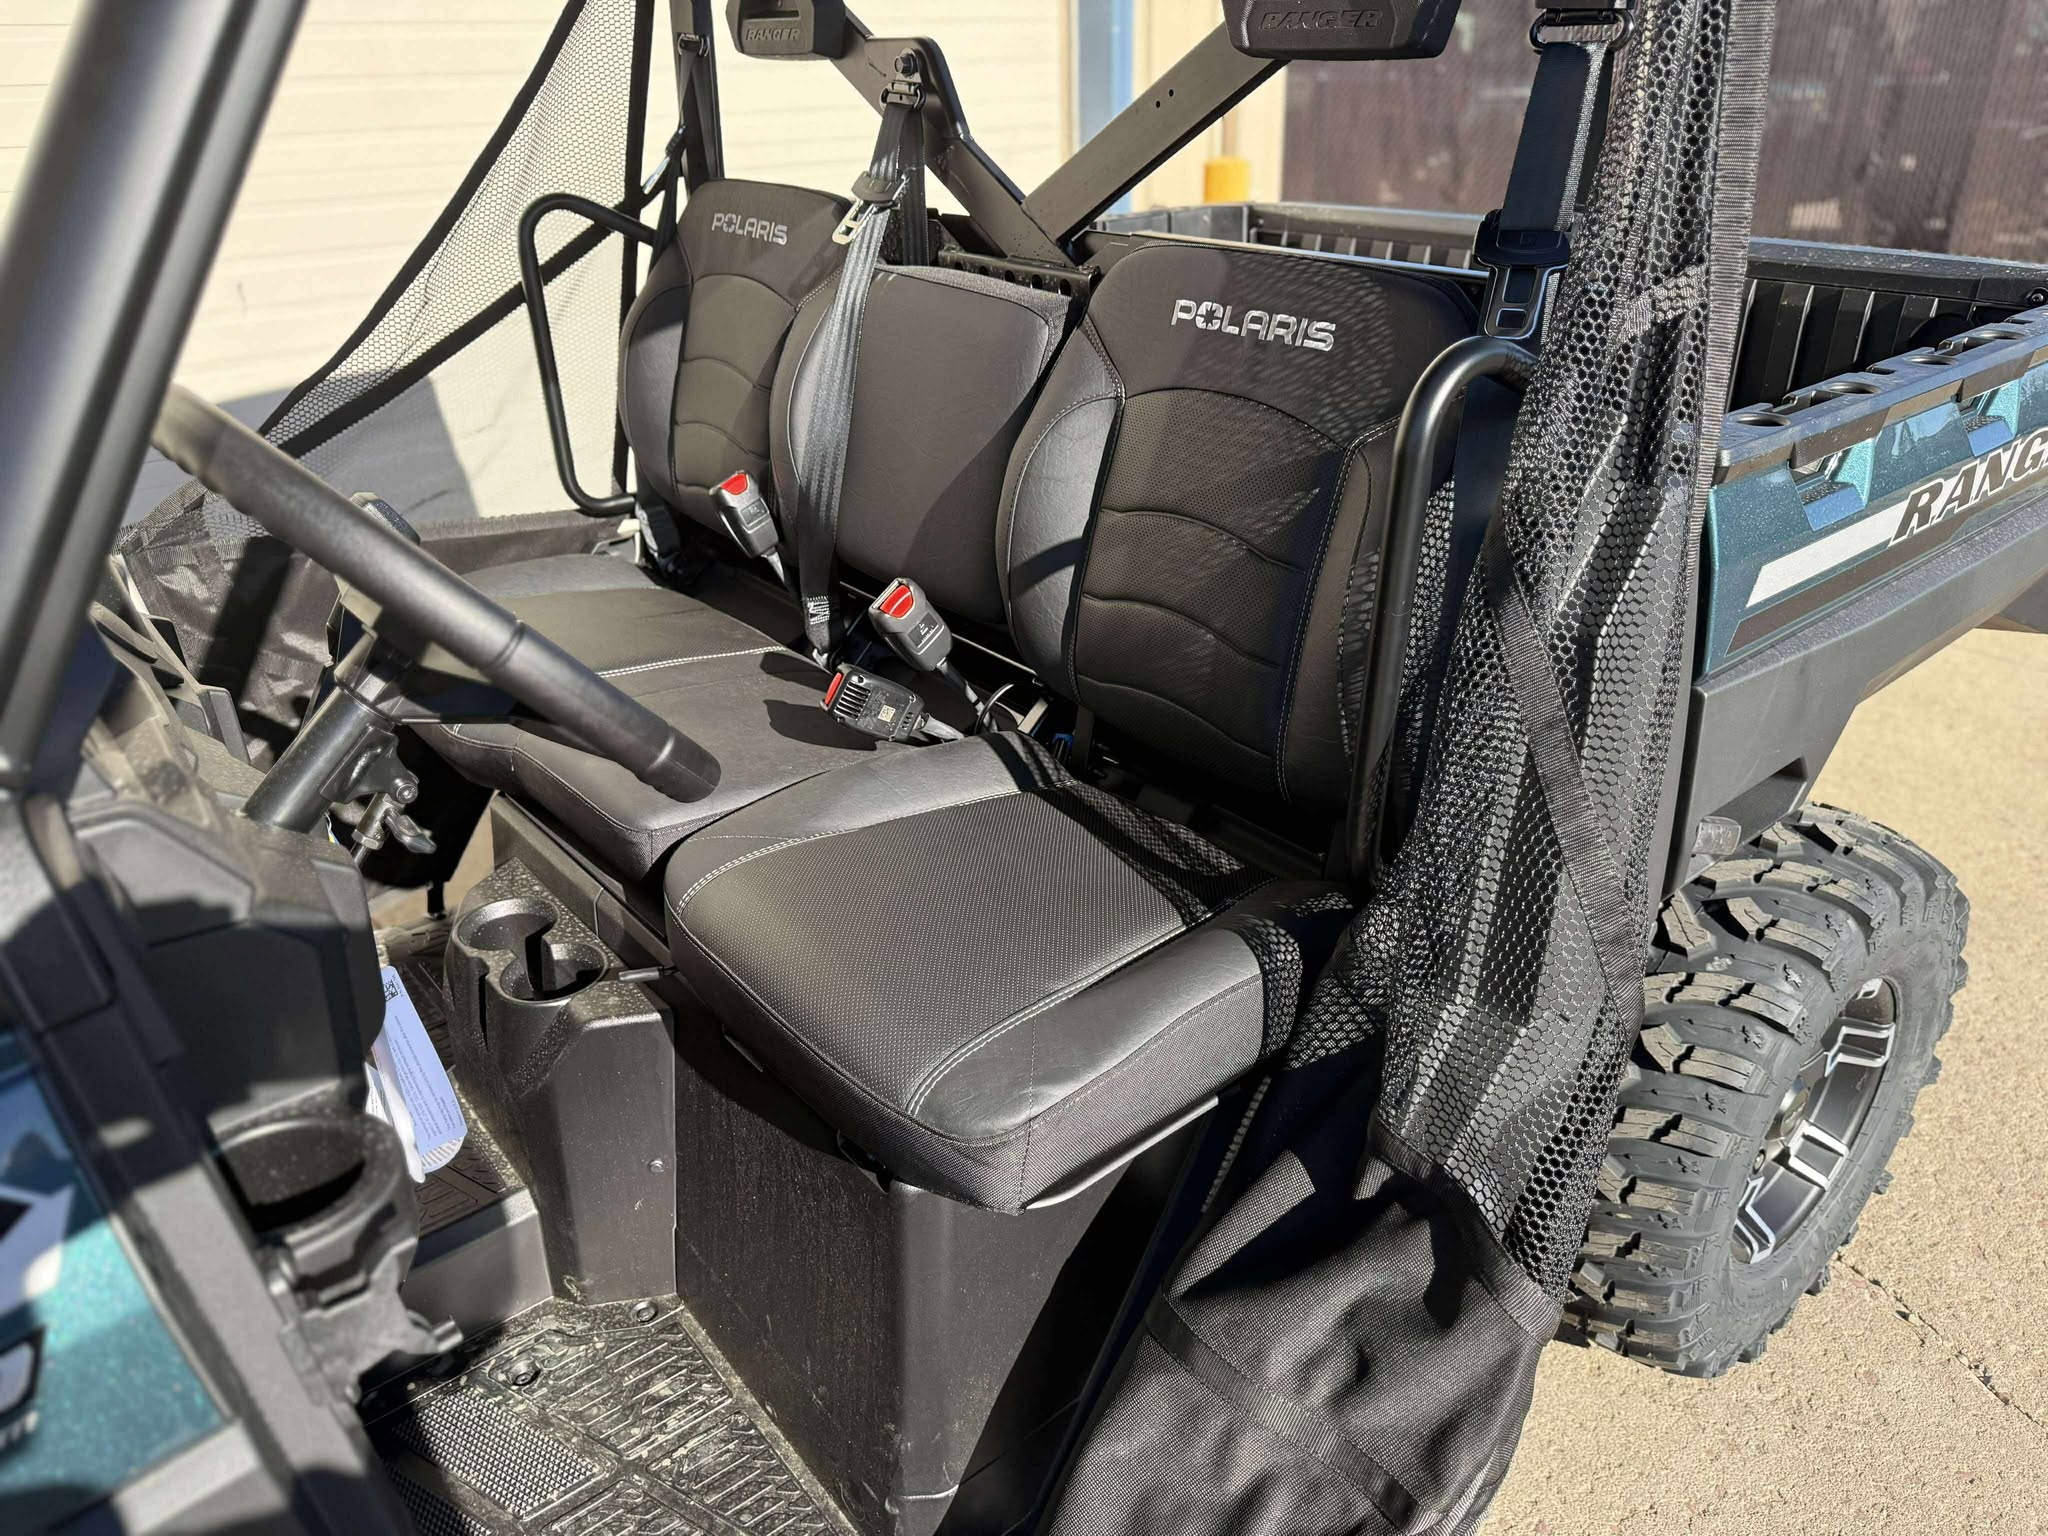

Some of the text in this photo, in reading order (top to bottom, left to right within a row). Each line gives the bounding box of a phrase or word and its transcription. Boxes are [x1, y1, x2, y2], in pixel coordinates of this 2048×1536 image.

[745, 27, 801, 41] RANGER
[1258, 9, 1383, 30] RANGER
[711, 212, 788, 246] POLARIS
[1170, 299, 1337, 352] POLARIS
[1888, 427, 2048, 547] RANG
